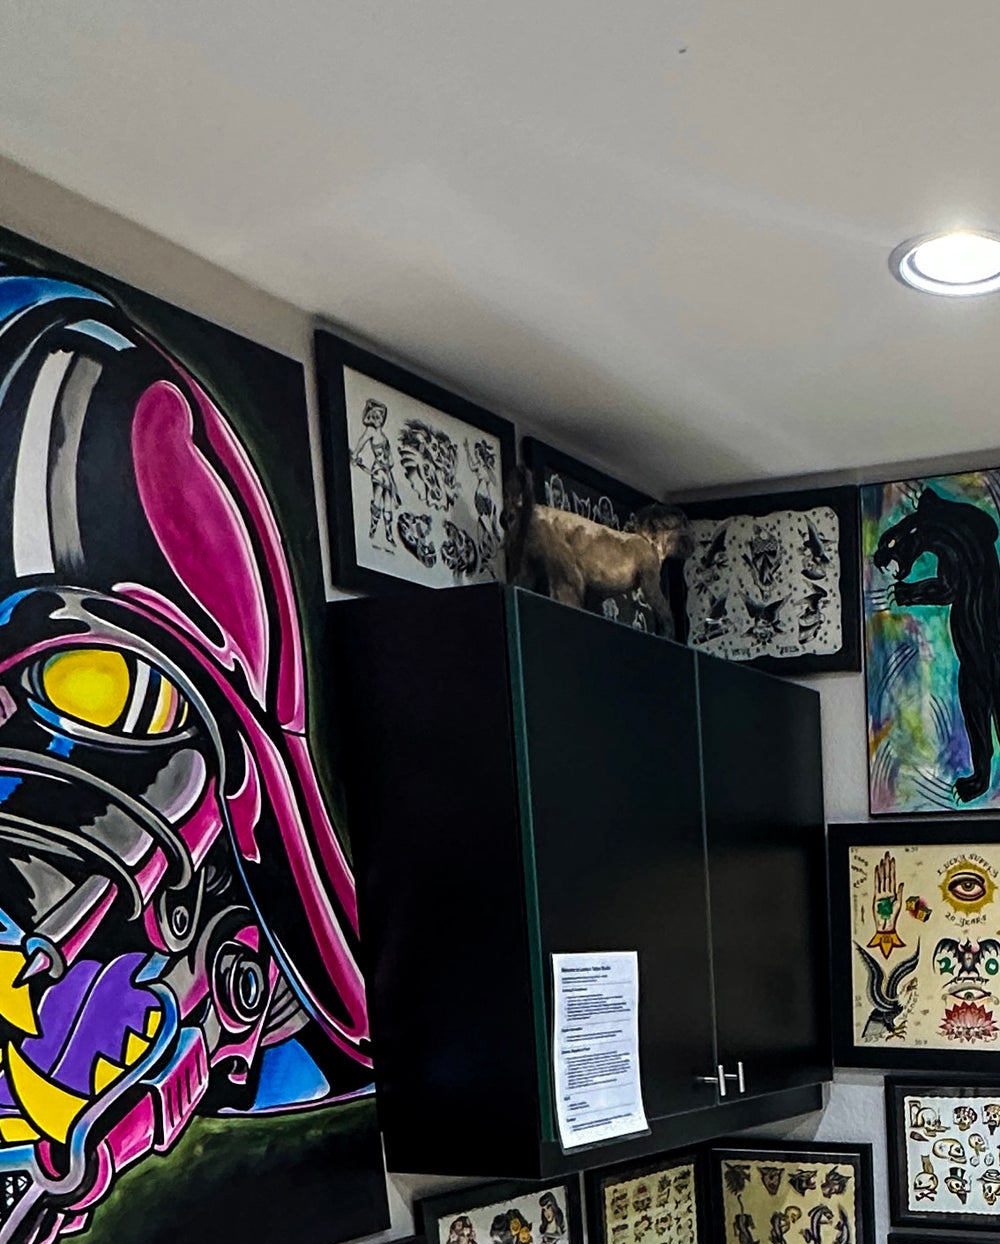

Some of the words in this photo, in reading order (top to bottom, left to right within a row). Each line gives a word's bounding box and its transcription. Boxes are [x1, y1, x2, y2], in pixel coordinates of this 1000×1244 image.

[937, 854, 967, 876] LUCKY
[968, 853, 999, 879] SUPPLY
[945, 911, 956, 921] 20
[937, 957, 956, 976] 2
